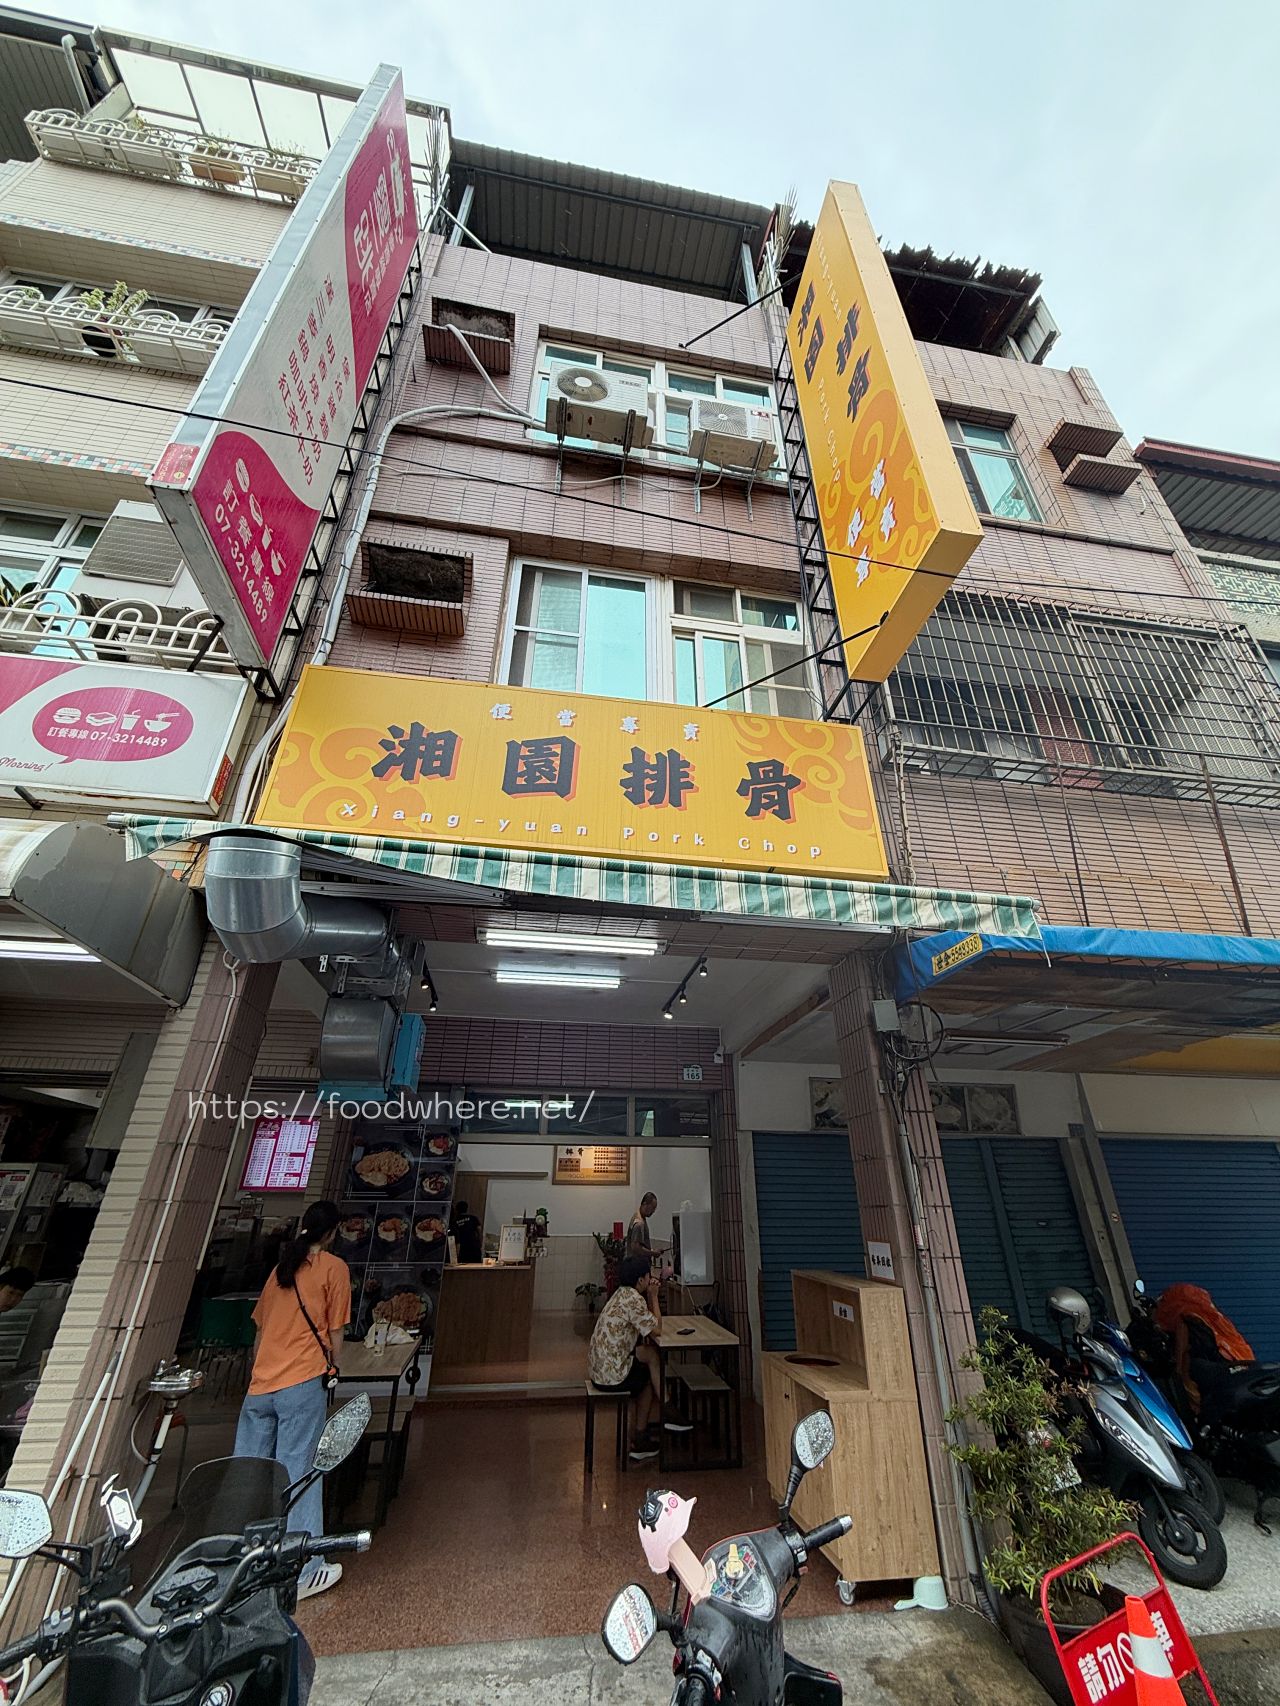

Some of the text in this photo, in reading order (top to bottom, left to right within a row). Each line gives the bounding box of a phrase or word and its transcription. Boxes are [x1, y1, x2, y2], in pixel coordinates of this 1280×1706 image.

[307, 308, 337, 422] 麥香雞
[315, 290, 343, 401] 三明治
[323, 272, 350, 384] 漢堡
[797, 280, 826, 385] 湘園
[836, 299, 872, 424] 排骨
[278, 371, 313, 486] 紅茶牛奶
[288, 349, 322, 463] 咖啡牛奶
[297, 328, 329, 441] 鍋燒麵
[214, 502, 268, 624] 07-3214489
[222, 479, 275, 607] 訂餐專線
[47, 727, 168, 748] 訂餐專線 07-3214489
[371, 721, 804, 823] 湘園排骨
[489, 703, 700, 742] 便當專賣
[623, 826, 706, 846] Pork
[738, 837, 822, 858] Chop
[686, 1072, 700, 1080] 165
[1077, 1642, 1126, 1704] 請勿
